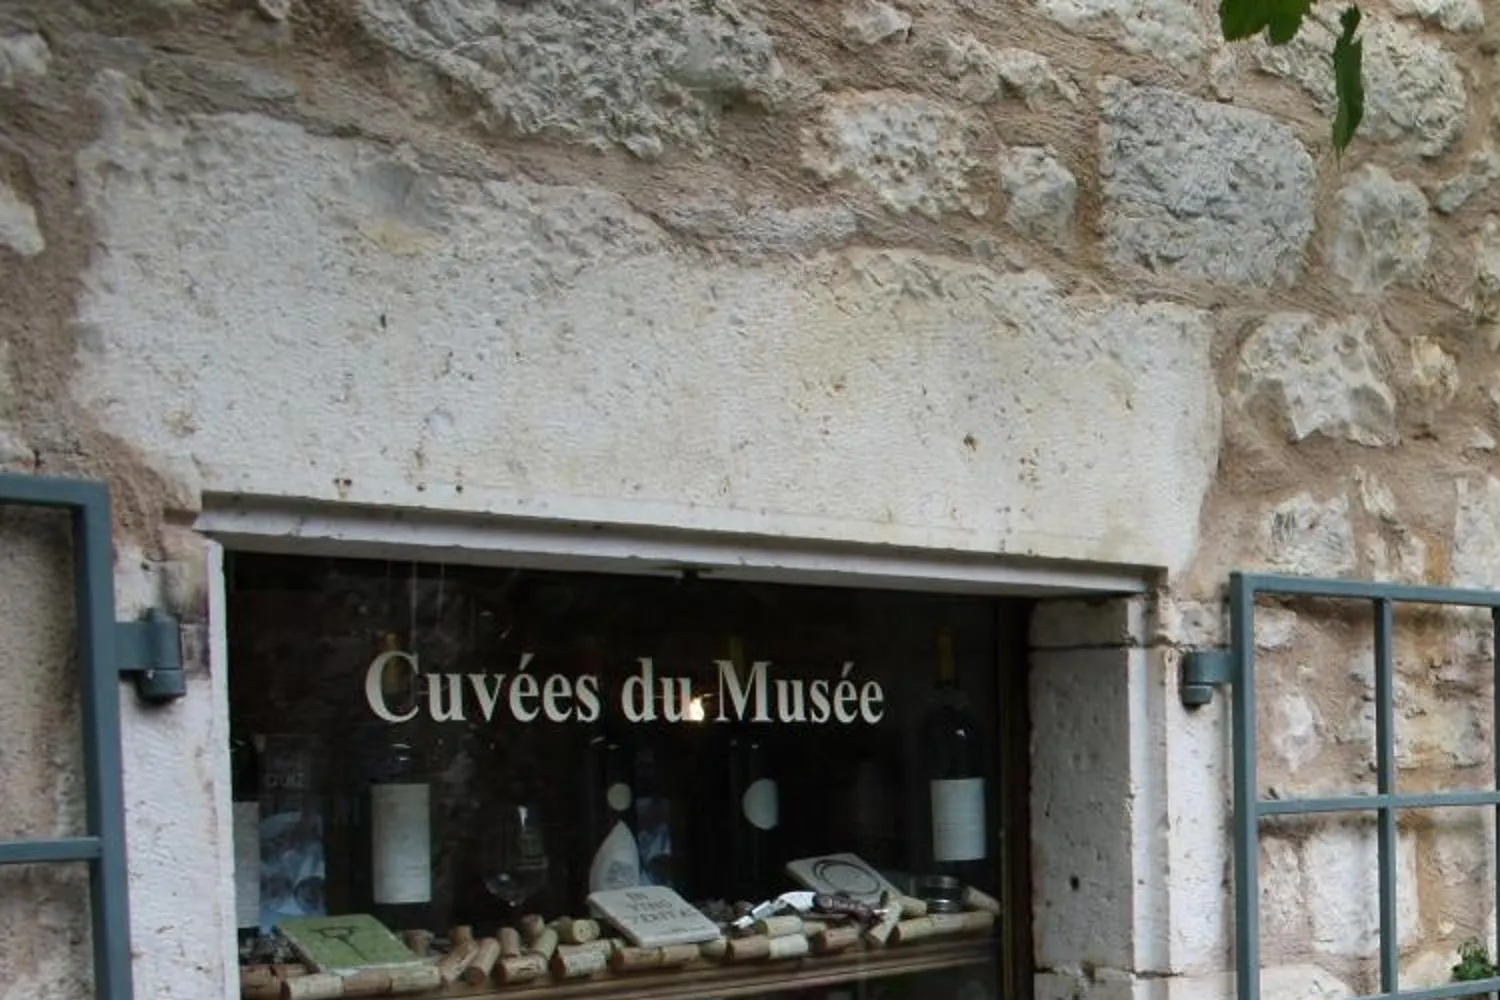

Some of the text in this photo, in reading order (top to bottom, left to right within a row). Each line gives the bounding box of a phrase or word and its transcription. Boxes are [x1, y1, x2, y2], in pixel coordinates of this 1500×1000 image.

[364, 652, 884, 725] Cuvées du Musée
